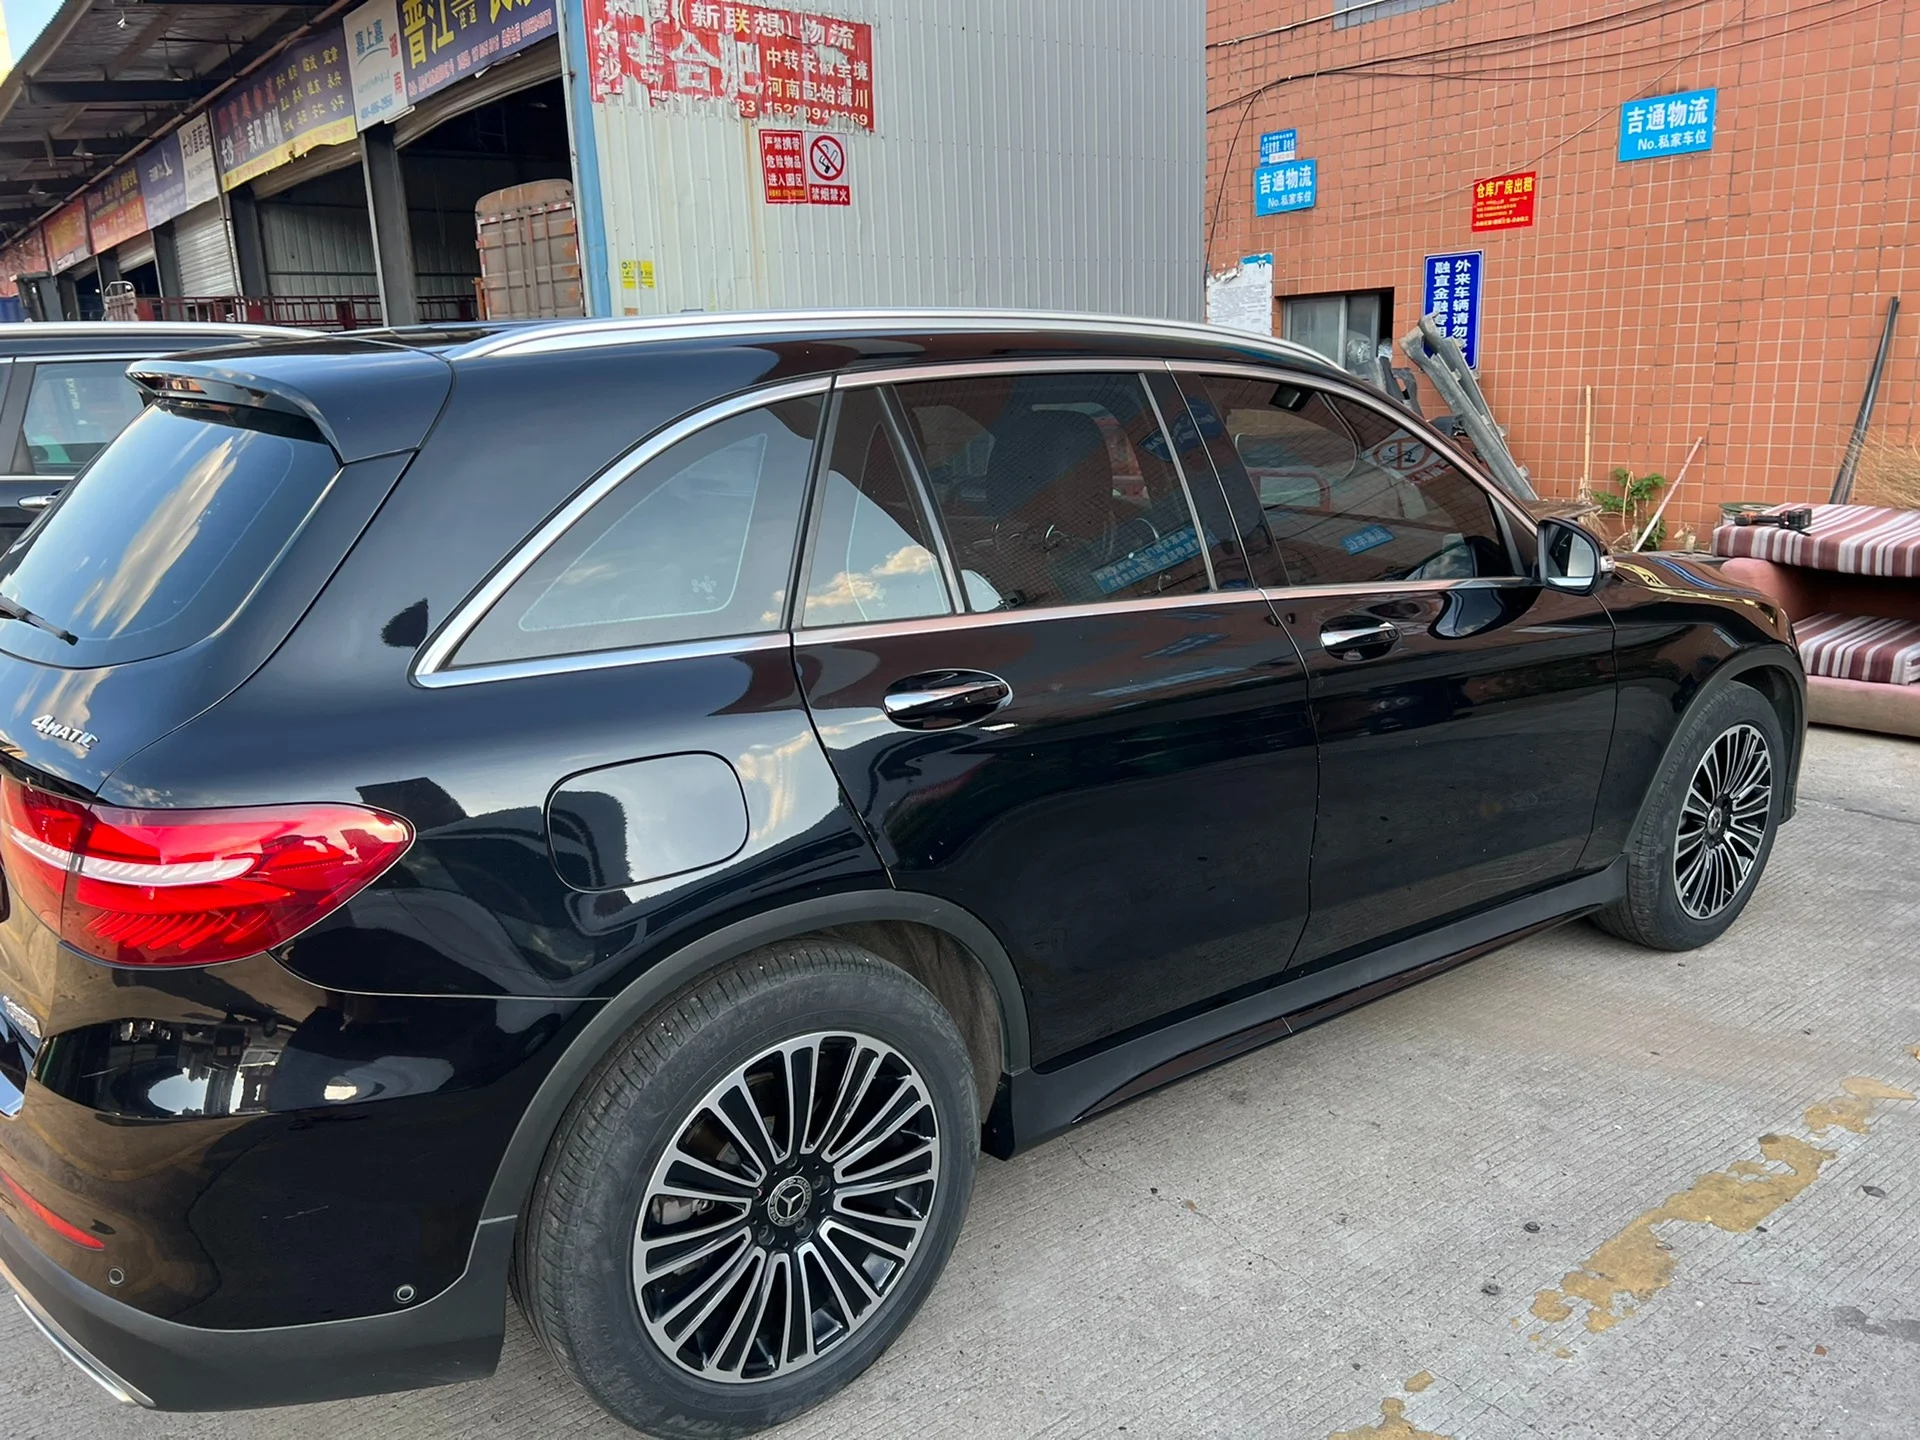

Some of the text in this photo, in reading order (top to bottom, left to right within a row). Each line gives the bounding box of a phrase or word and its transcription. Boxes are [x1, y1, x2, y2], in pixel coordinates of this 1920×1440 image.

[669, 29, 764, 98] 合肥
[1626, 96, 1710, 135] 吉通物流
[1637, 128, 1707, 151] No.私家车位
[766, 155, 802, 168] 危险物品
[811, 187, 848, 201] 禁烟禁火
[1259, 165, 1313, 195] 吉通物流
[1476, 177, 1533, 198] 仓库厂房出租
[1451, 259, 1472, 358] 外来车辆请勿
[31, 714, 99, 750] 4MATIC
